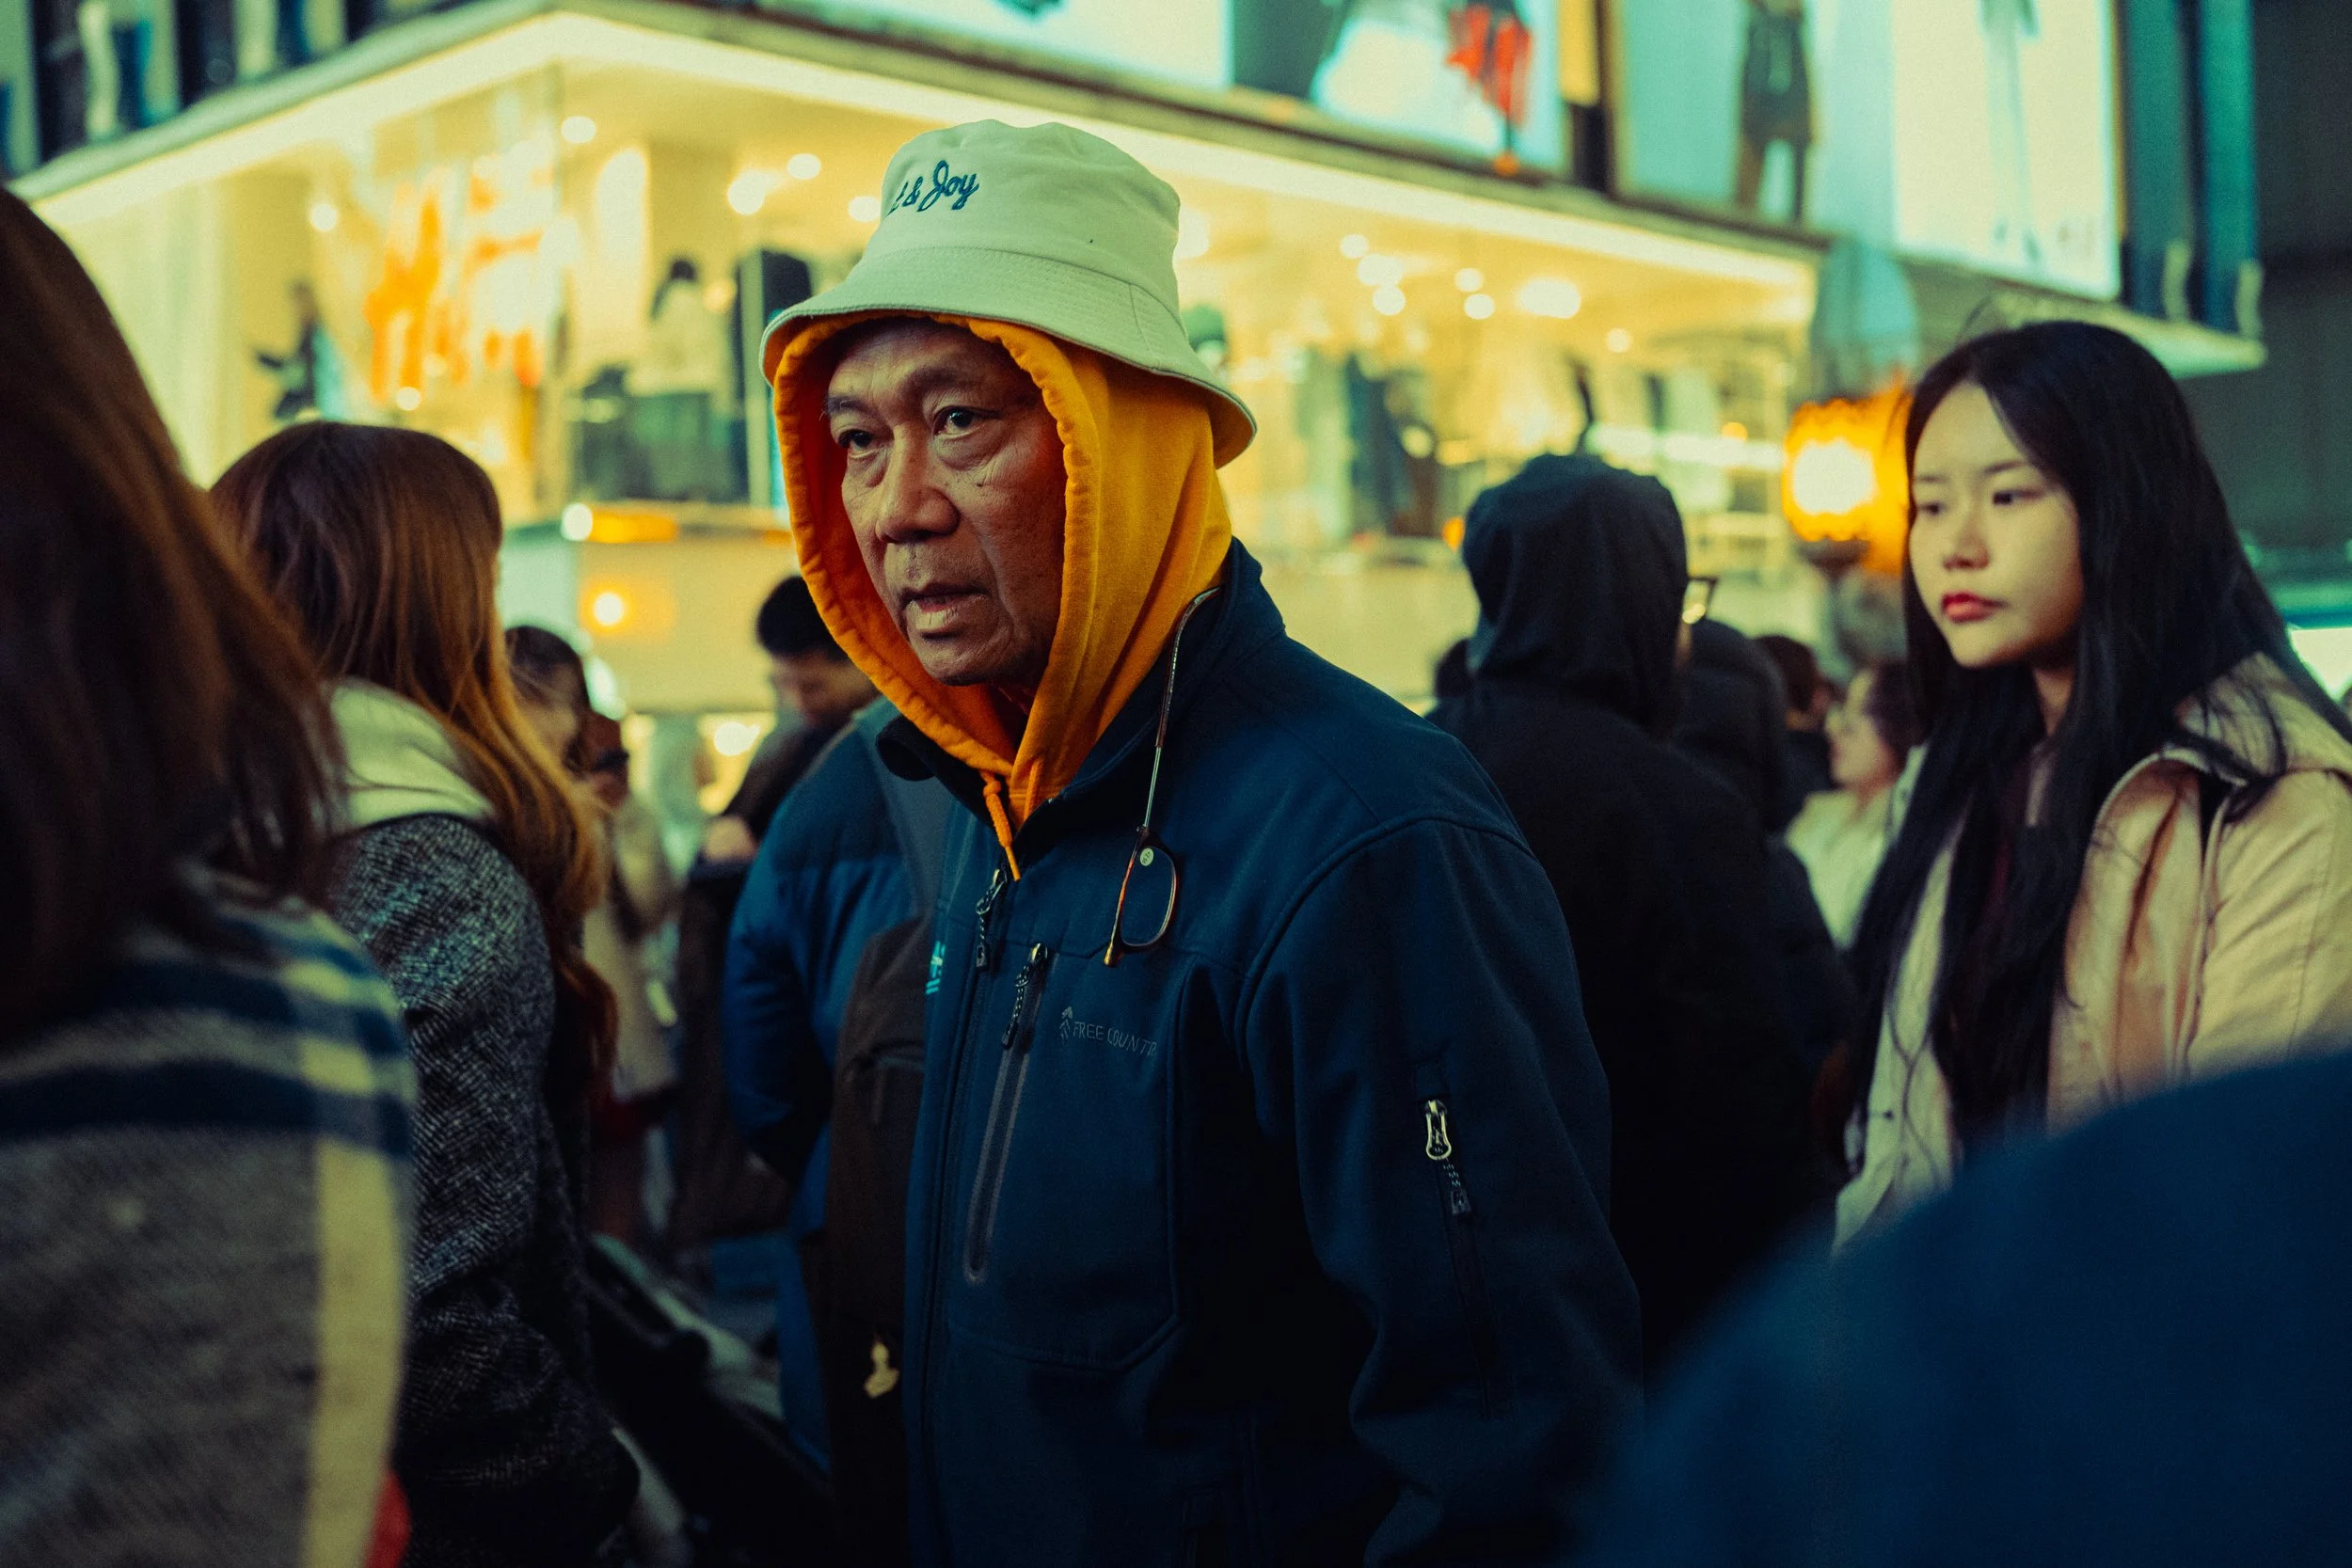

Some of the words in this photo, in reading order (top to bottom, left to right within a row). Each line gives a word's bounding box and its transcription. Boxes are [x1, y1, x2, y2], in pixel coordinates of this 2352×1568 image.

[901, 175, 924, 207] &
[916, 159, 980, 213] Joy
[1073, 1021, 1104, 1041] FREE
[1107, 1026, 1158, 1058] COUNTR
